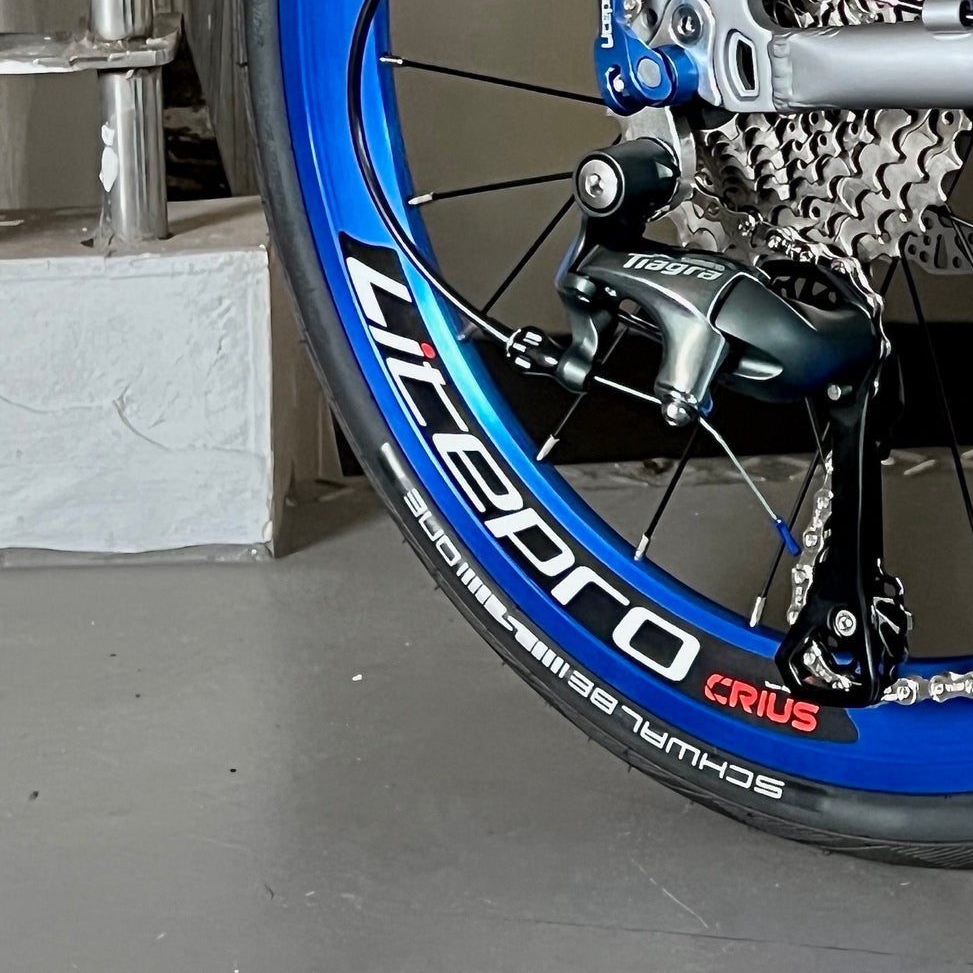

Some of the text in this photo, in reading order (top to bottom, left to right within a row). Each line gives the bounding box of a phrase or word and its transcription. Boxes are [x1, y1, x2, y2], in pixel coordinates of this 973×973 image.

[623, 252, 724, 281] Tiagra
[346, 256, 700, 682] Litepro
[403, 489, 785, 800] SCHWALBE ONE
[704, 673, 819, 732] CRIUS
